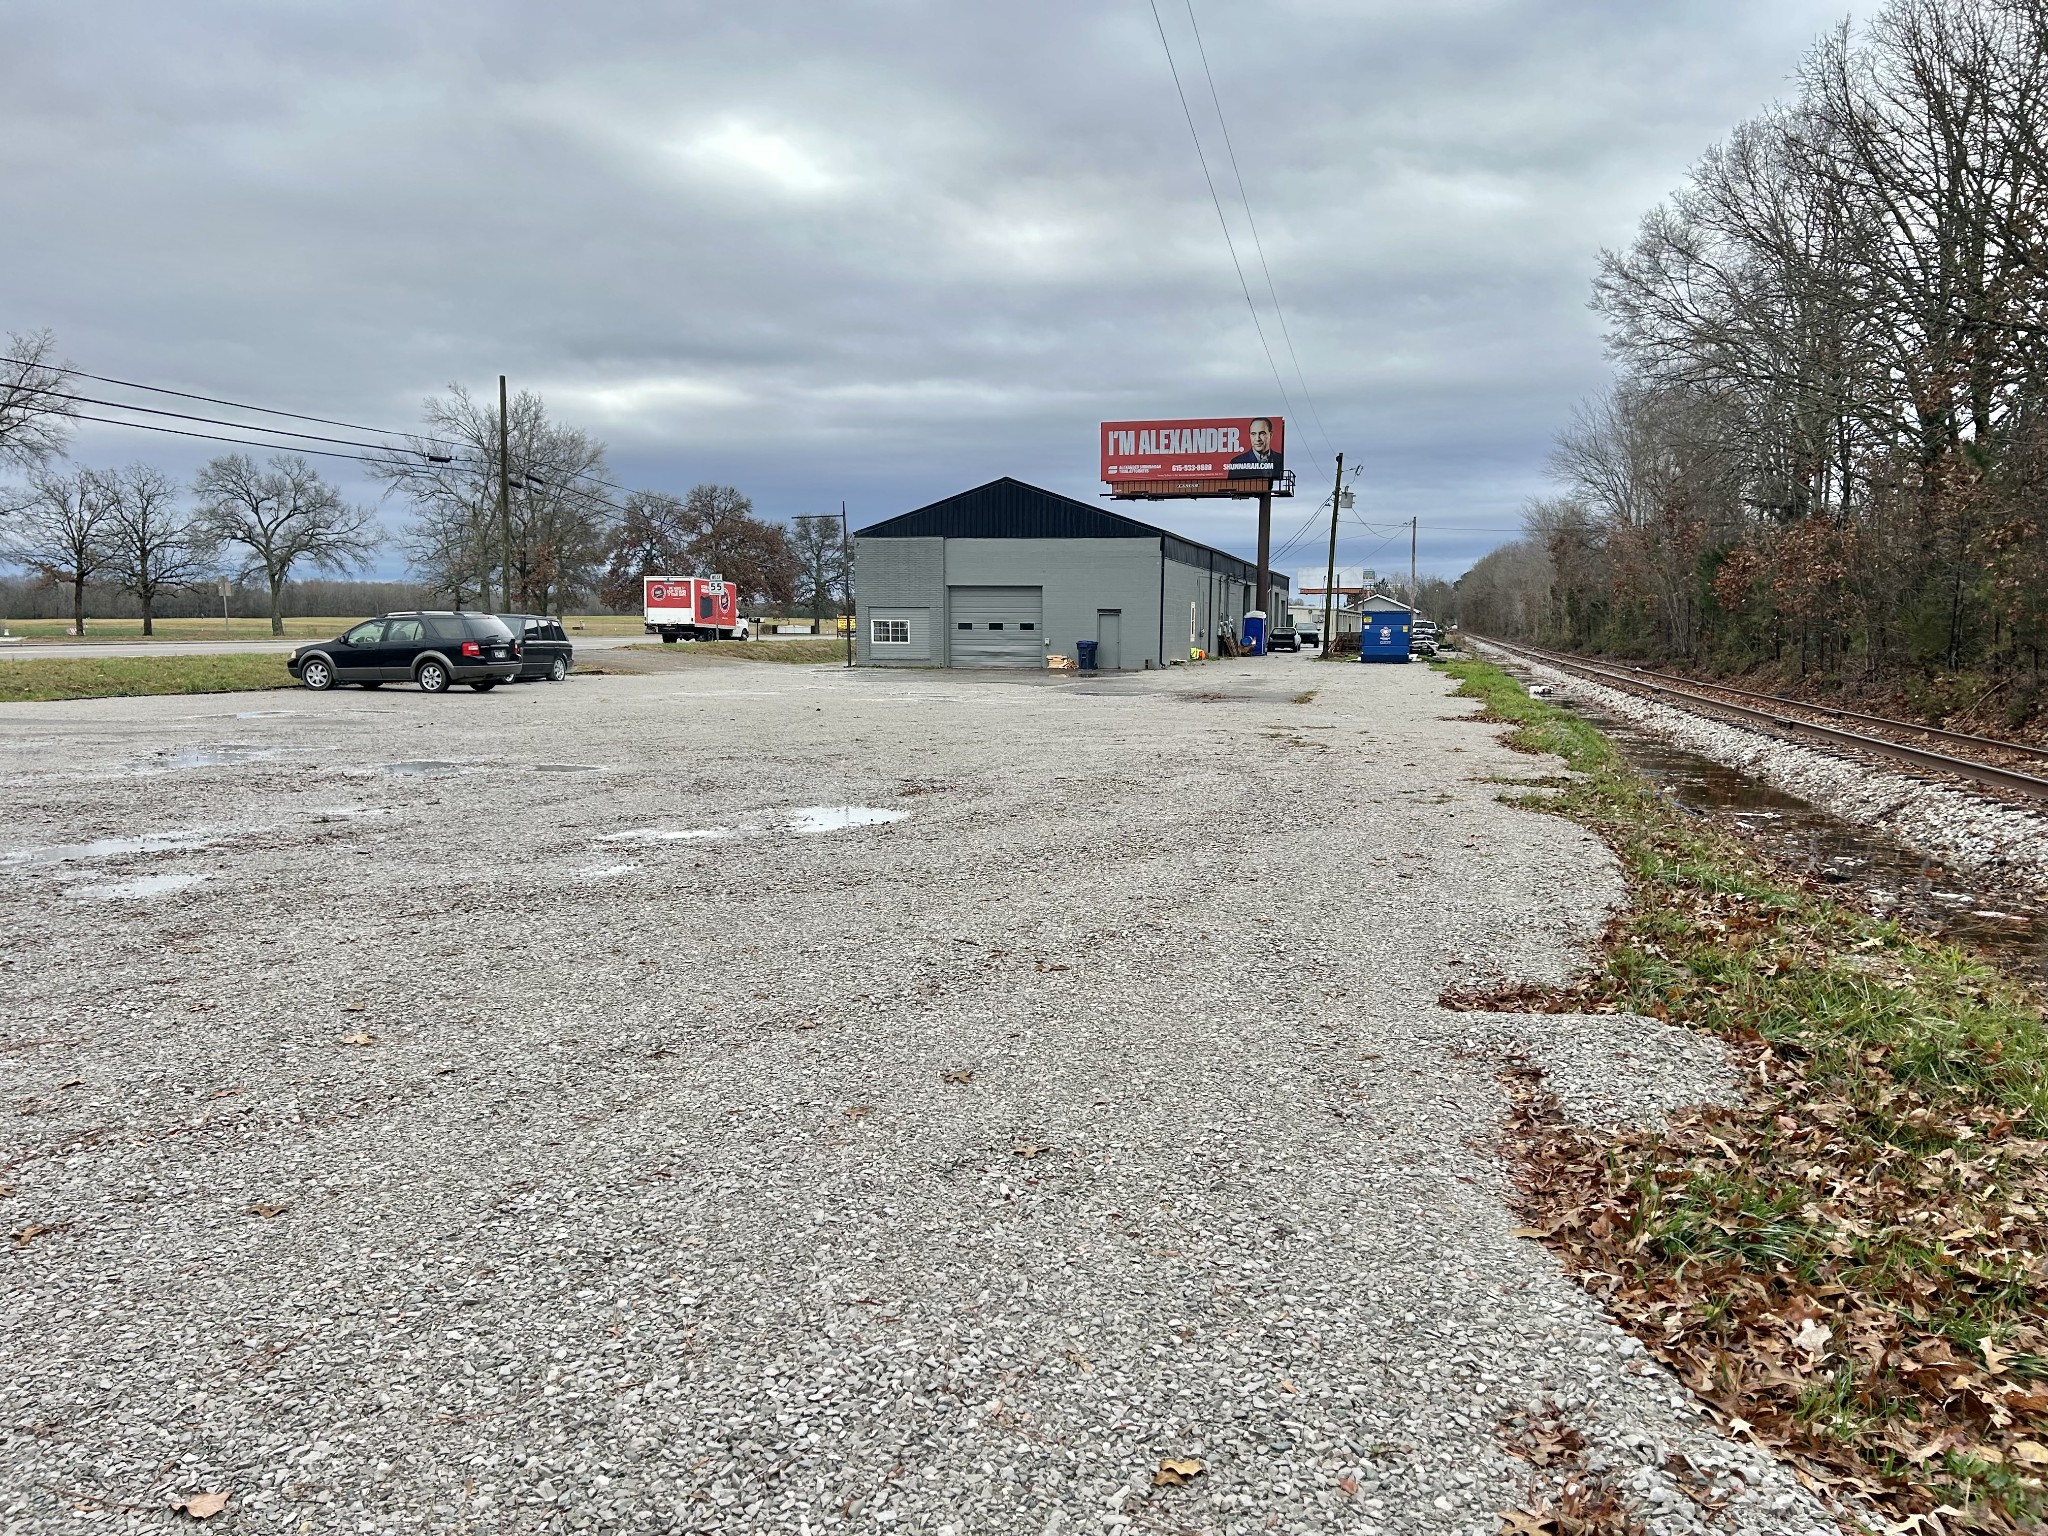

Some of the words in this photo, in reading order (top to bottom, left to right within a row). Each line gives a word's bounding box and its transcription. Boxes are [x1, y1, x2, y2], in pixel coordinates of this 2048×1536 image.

[1108, 430, 1135, 456] I'M
[1138, 427, 1245, 455] ALEXANDER.
[711, 583, 722, 591] 55
